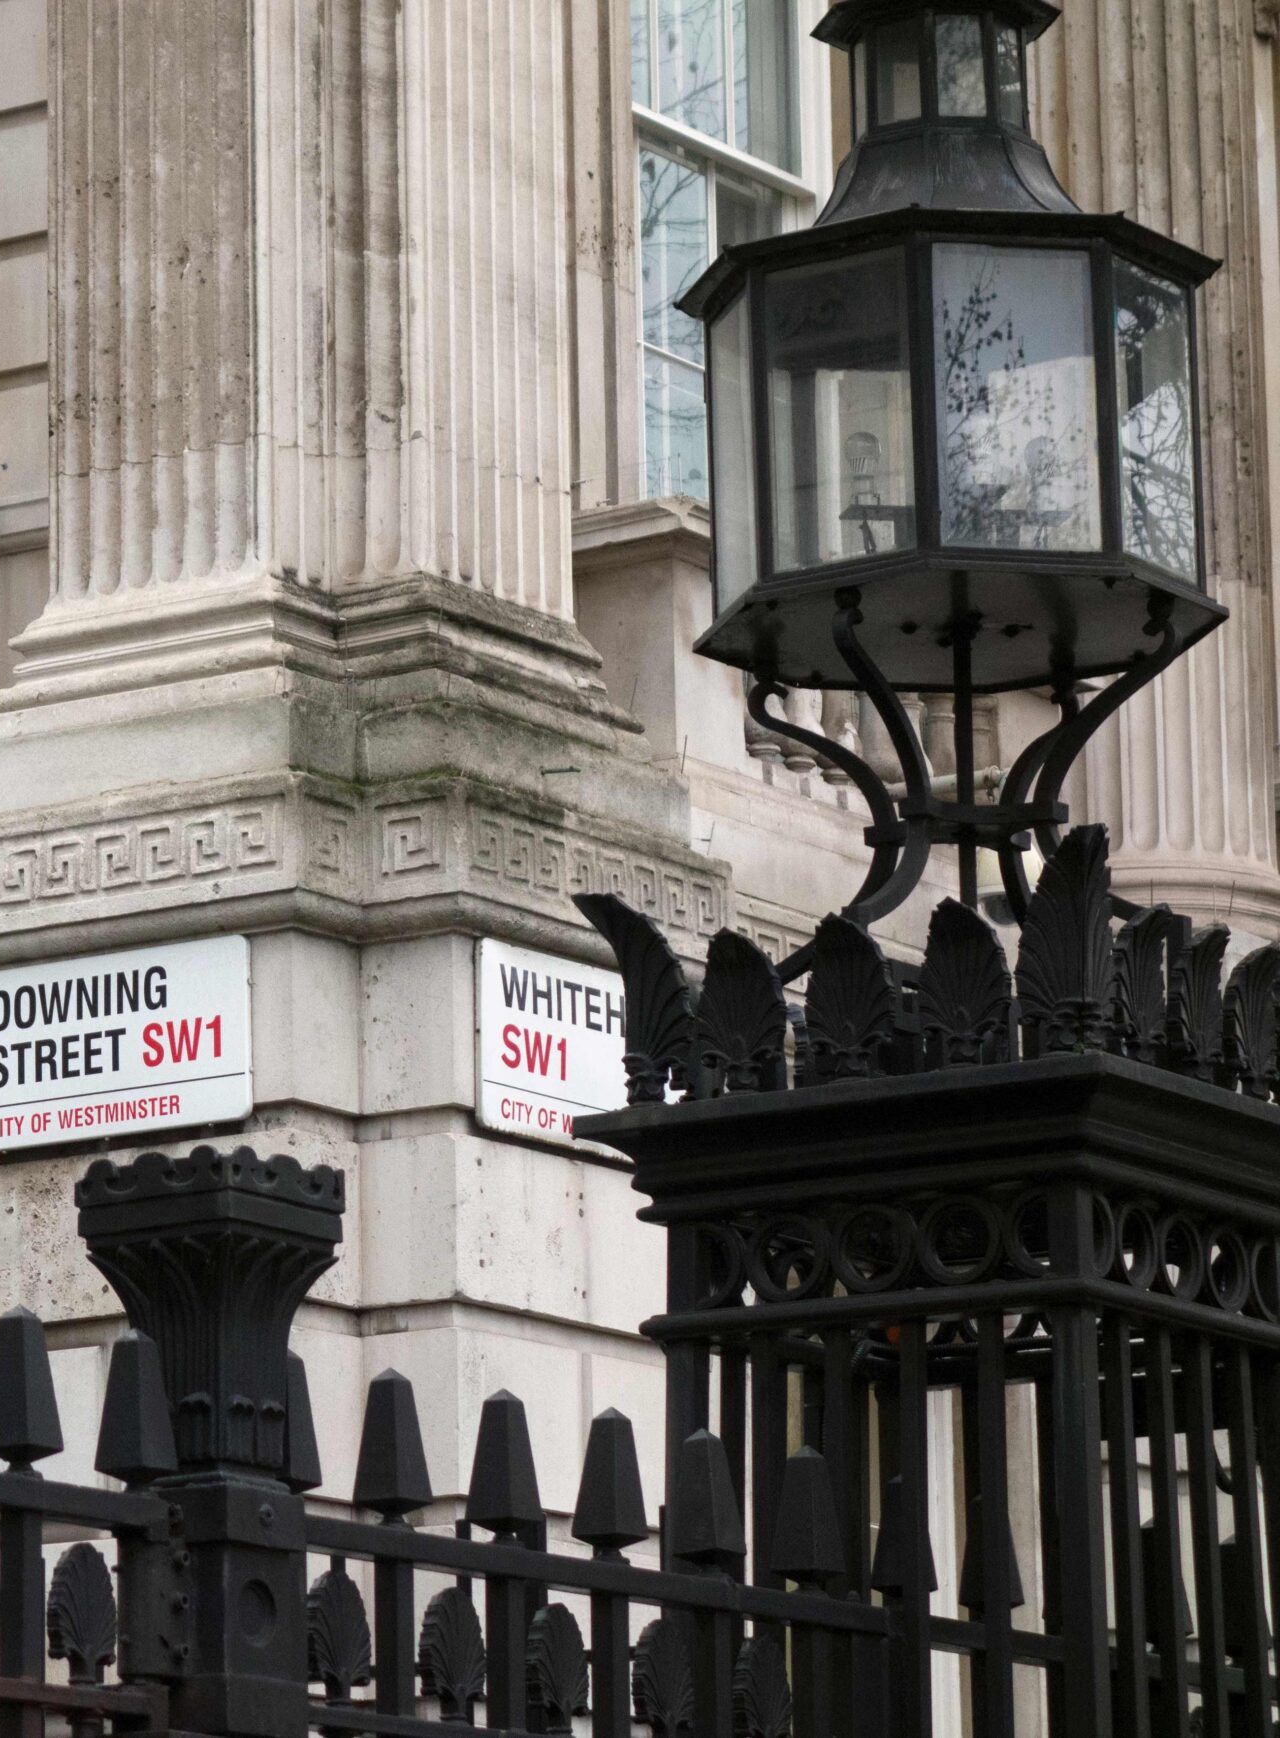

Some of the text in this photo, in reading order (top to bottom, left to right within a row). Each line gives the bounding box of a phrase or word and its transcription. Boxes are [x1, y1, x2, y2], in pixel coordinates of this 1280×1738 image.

[142, 1014, 222, 1068] SW1
[501, 1023, 567, 1081] SW1
[31, 1112, 51, 1133] OF
[57, 1094, 180, 1129] WESTMINSTER
[501, 1098, 533, 1125] CITY
[538, 1107, 557, 1130] OF
